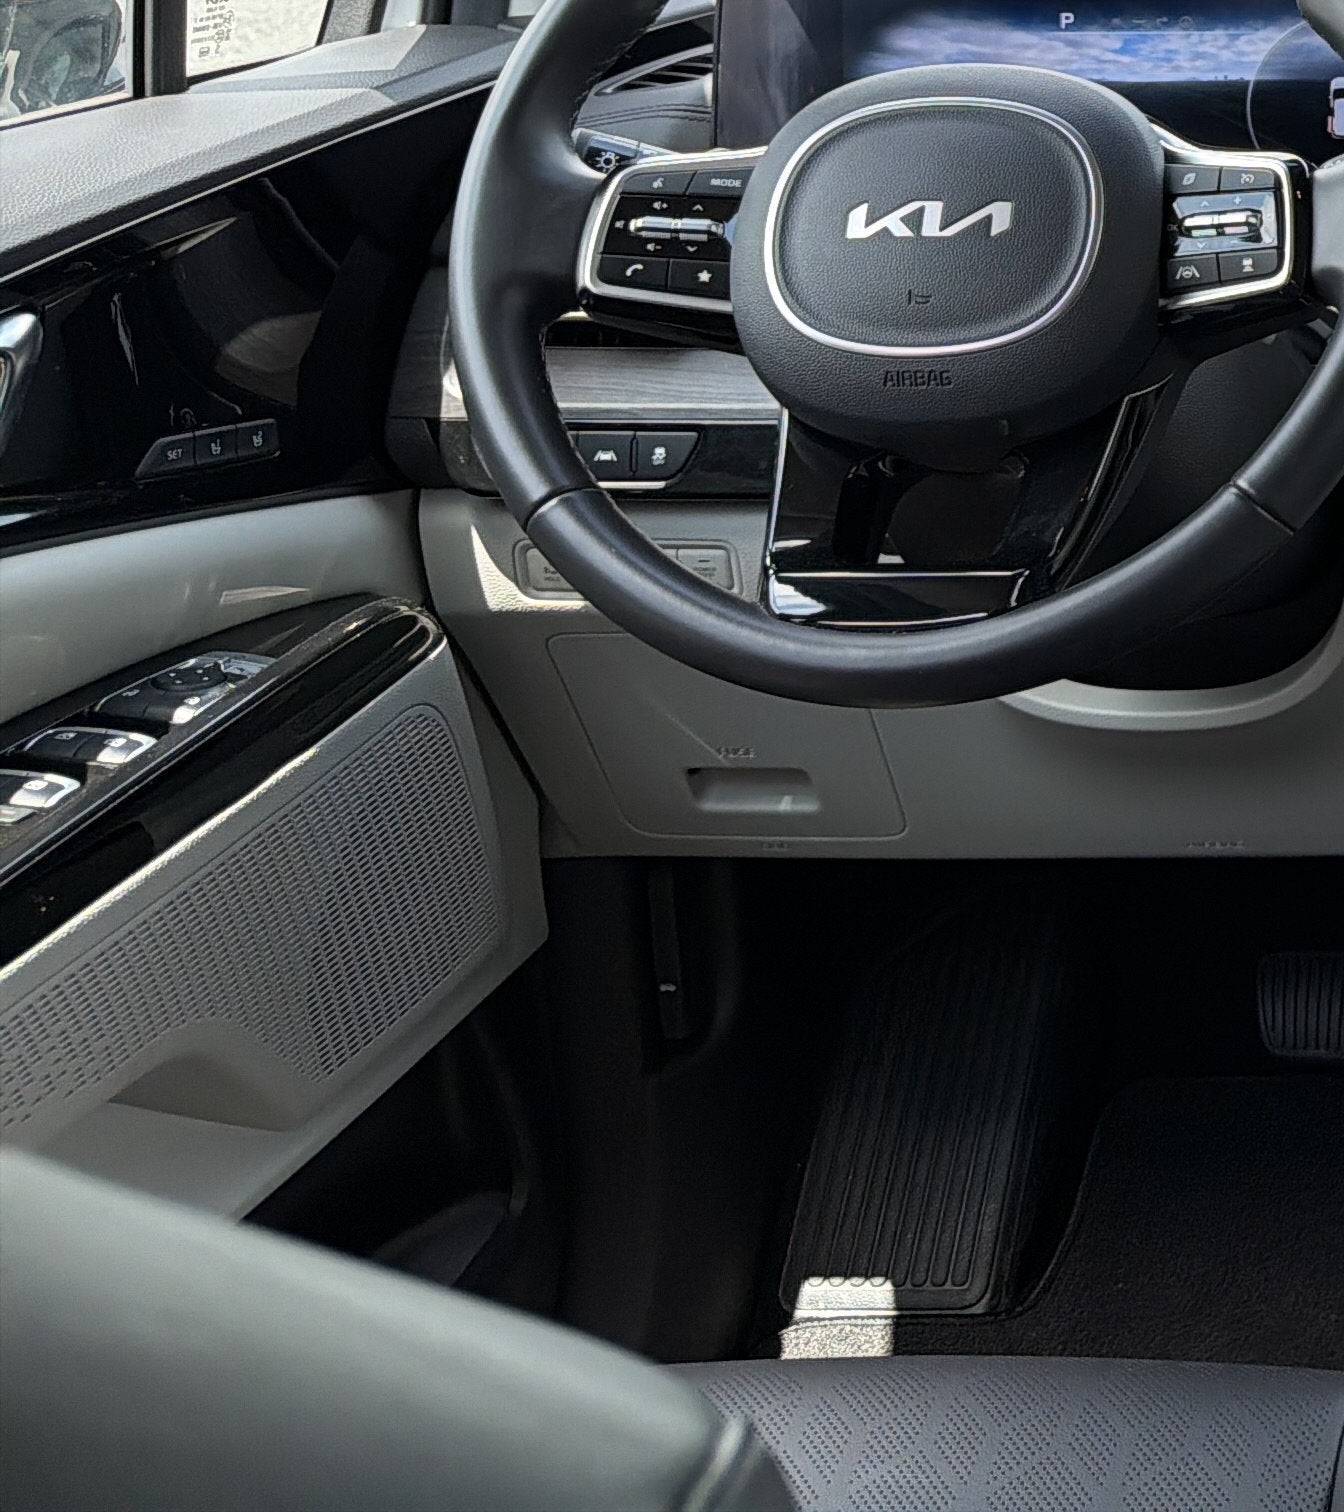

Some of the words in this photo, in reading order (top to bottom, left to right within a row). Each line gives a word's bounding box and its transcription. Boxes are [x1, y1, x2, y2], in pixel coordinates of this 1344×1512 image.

[1059, 12, 1075, 29] P
[709, 177, 743, 188] MODE
[846, 199, 1015, 240] KIA
[883, 369, 954, 389] AIRBAG
[167, 448, 183, 461] SET
